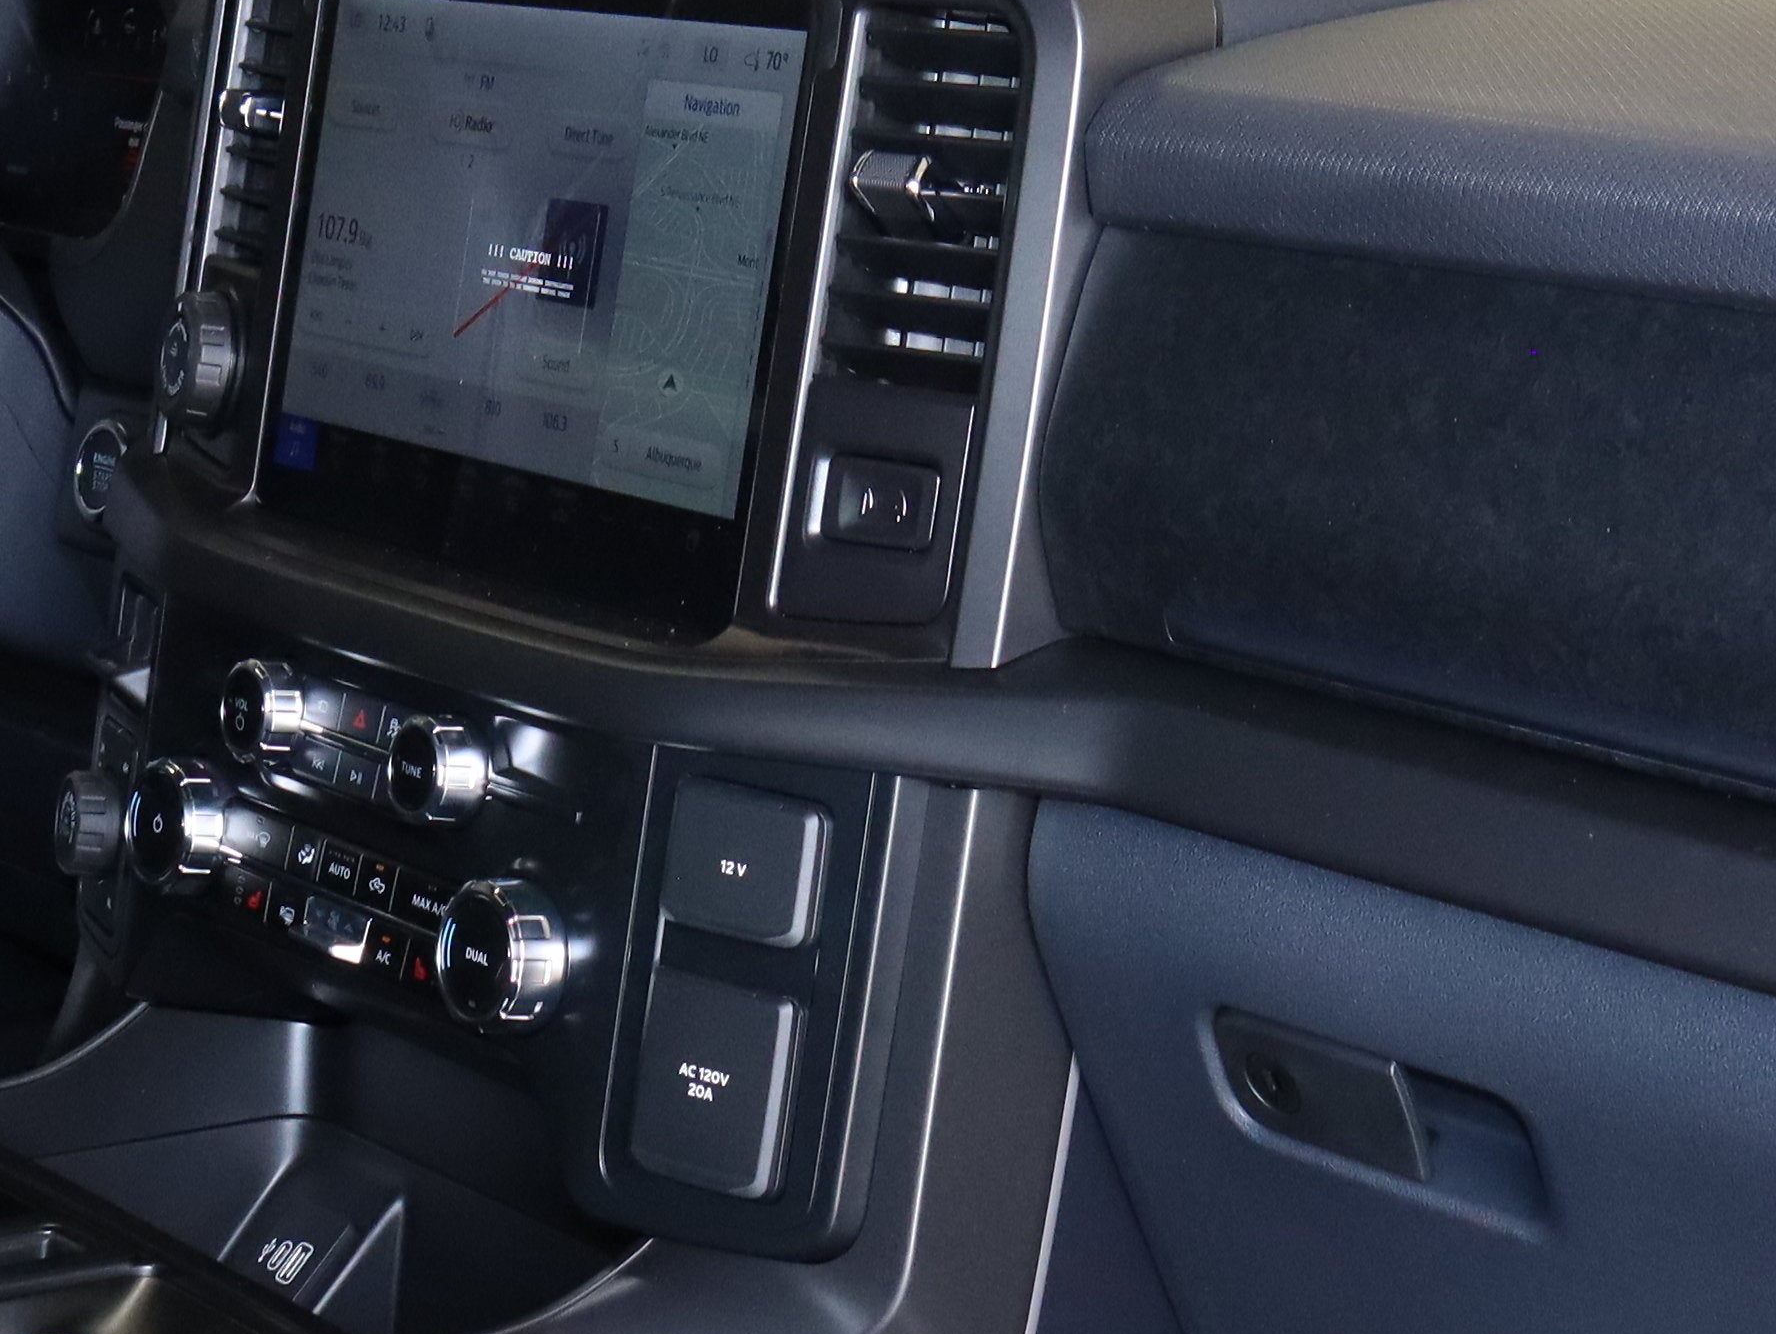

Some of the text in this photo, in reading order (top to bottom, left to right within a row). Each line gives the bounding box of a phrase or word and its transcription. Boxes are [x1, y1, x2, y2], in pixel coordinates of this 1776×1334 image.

[703, 46, 719, 64] LO
[684, 93, 741, 117] Navigation
[317, 212, 360, 246] 107.9
[509, 247, 552, 267] CAUTION
[645, 446, 703, 472] Albuquerque
[234, 697, 249, 713] VOL
[401, 760, 423, 780] TUNE
[328, 862, 351, 881] AUTO
[720, 859, 748, 878] 12 V
[411, 893, 432, 914] MAX
[374, 949, 392, 966] A/C
[465, 946, 490, 967] DUAL
[678, 1062, 731, 1088] AC 120V
[687, 1082, 714, 1103] 20A
